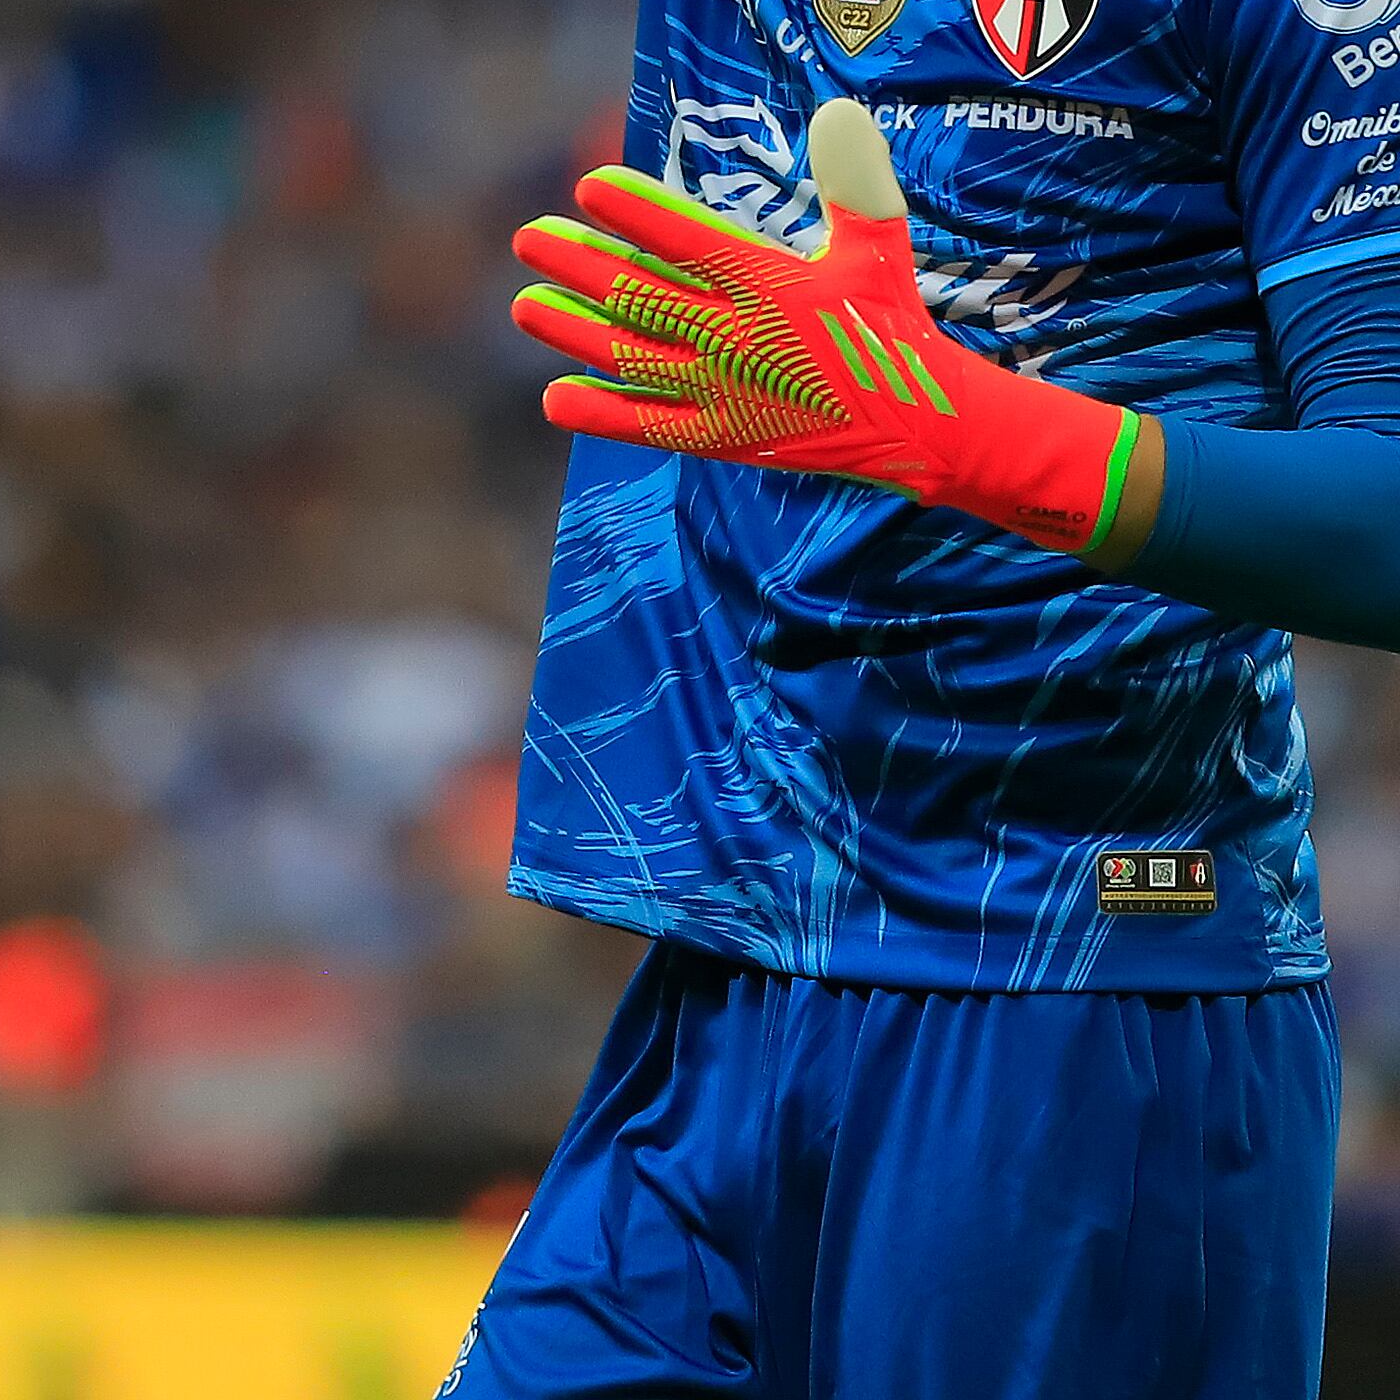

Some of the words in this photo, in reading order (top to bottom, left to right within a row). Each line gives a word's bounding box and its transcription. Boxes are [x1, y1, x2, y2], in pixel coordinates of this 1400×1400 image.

[839, 9, 870, 27] C22
[942, 96, 1135, 139] PERDURA
[1356, 140, 1396, 175] de
